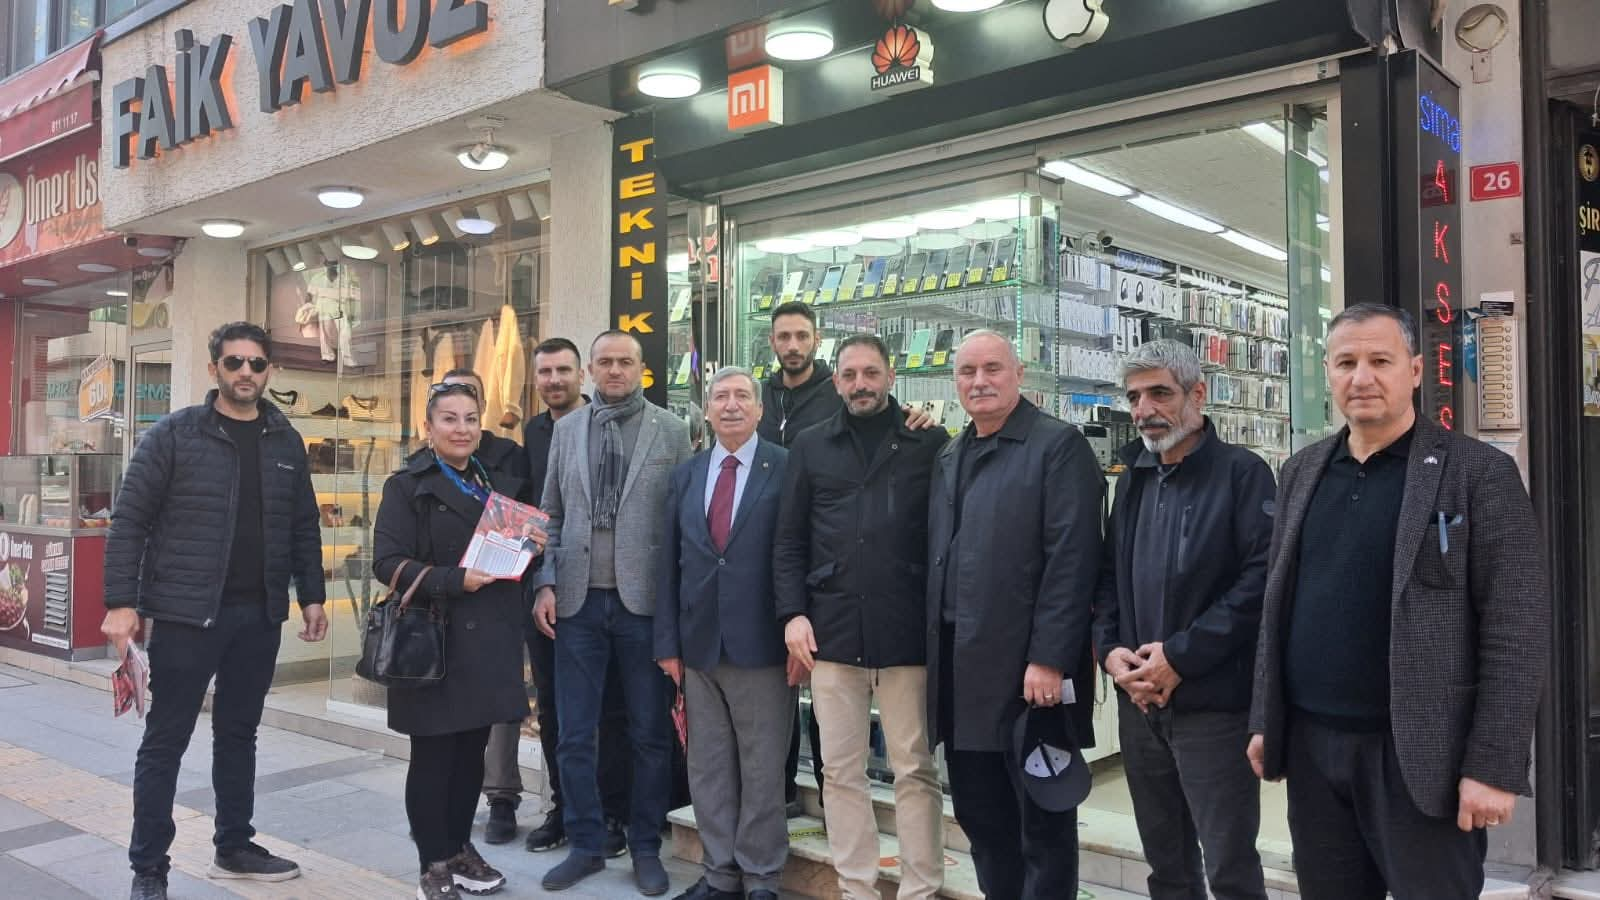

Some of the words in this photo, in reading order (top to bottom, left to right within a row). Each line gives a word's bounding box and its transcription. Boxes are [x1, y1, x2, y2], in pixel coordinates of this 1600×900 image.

[112, 29, 234, 168] FAİK
[872, 67, 919, 89] HUAWEI
[1483, 170, 1512, 192] 26
[618, 138, 656, 334] TEKNİK
